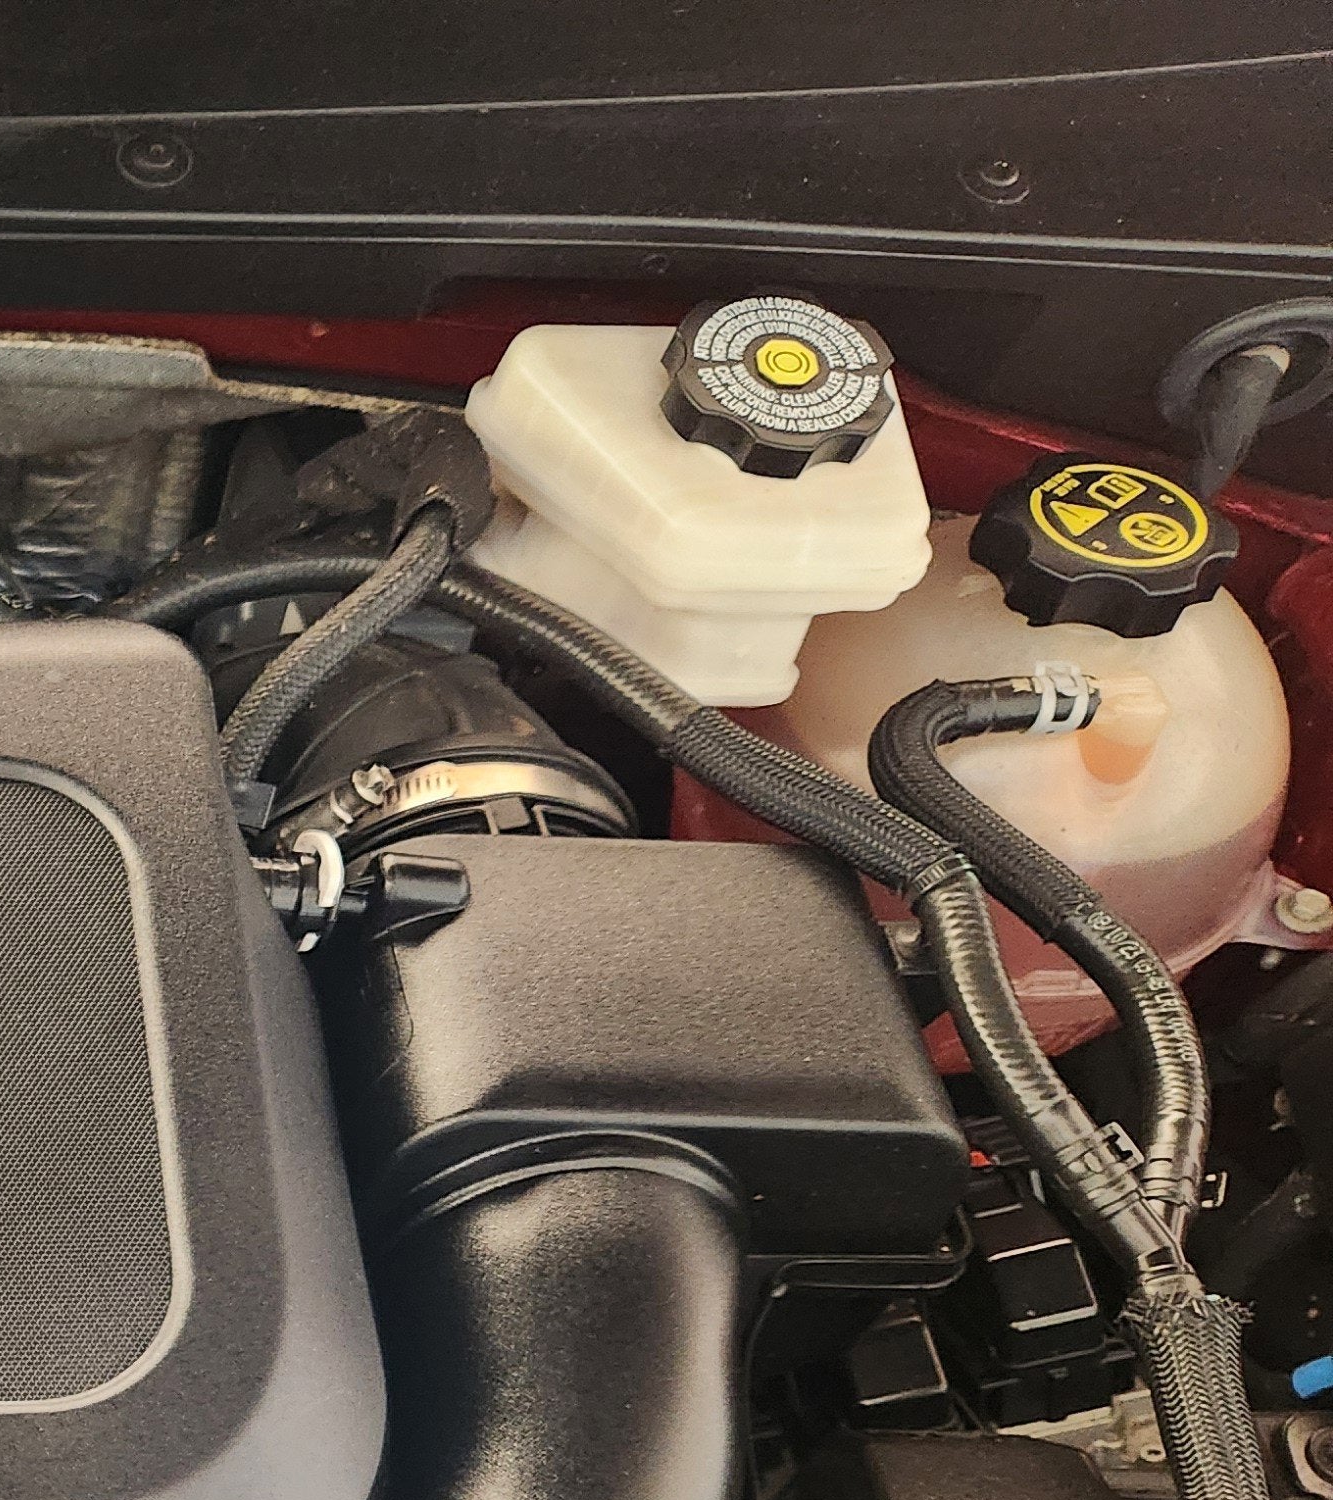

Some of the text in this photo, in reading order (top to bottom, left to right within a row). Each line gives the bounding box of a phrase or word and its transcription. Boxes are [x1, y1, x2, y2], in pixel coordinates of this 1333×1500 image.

[714, 365, 738, 386] CAP
[726, 382, 772, 414] BEFORE
[779, 391, 824, 406] CLEAN
[715, 390, 752, 417] FLUID
[746, 409, 786, 430] FROM
[786, 419, 797, 431] A
[796, 413, 847, 431] SEALED
